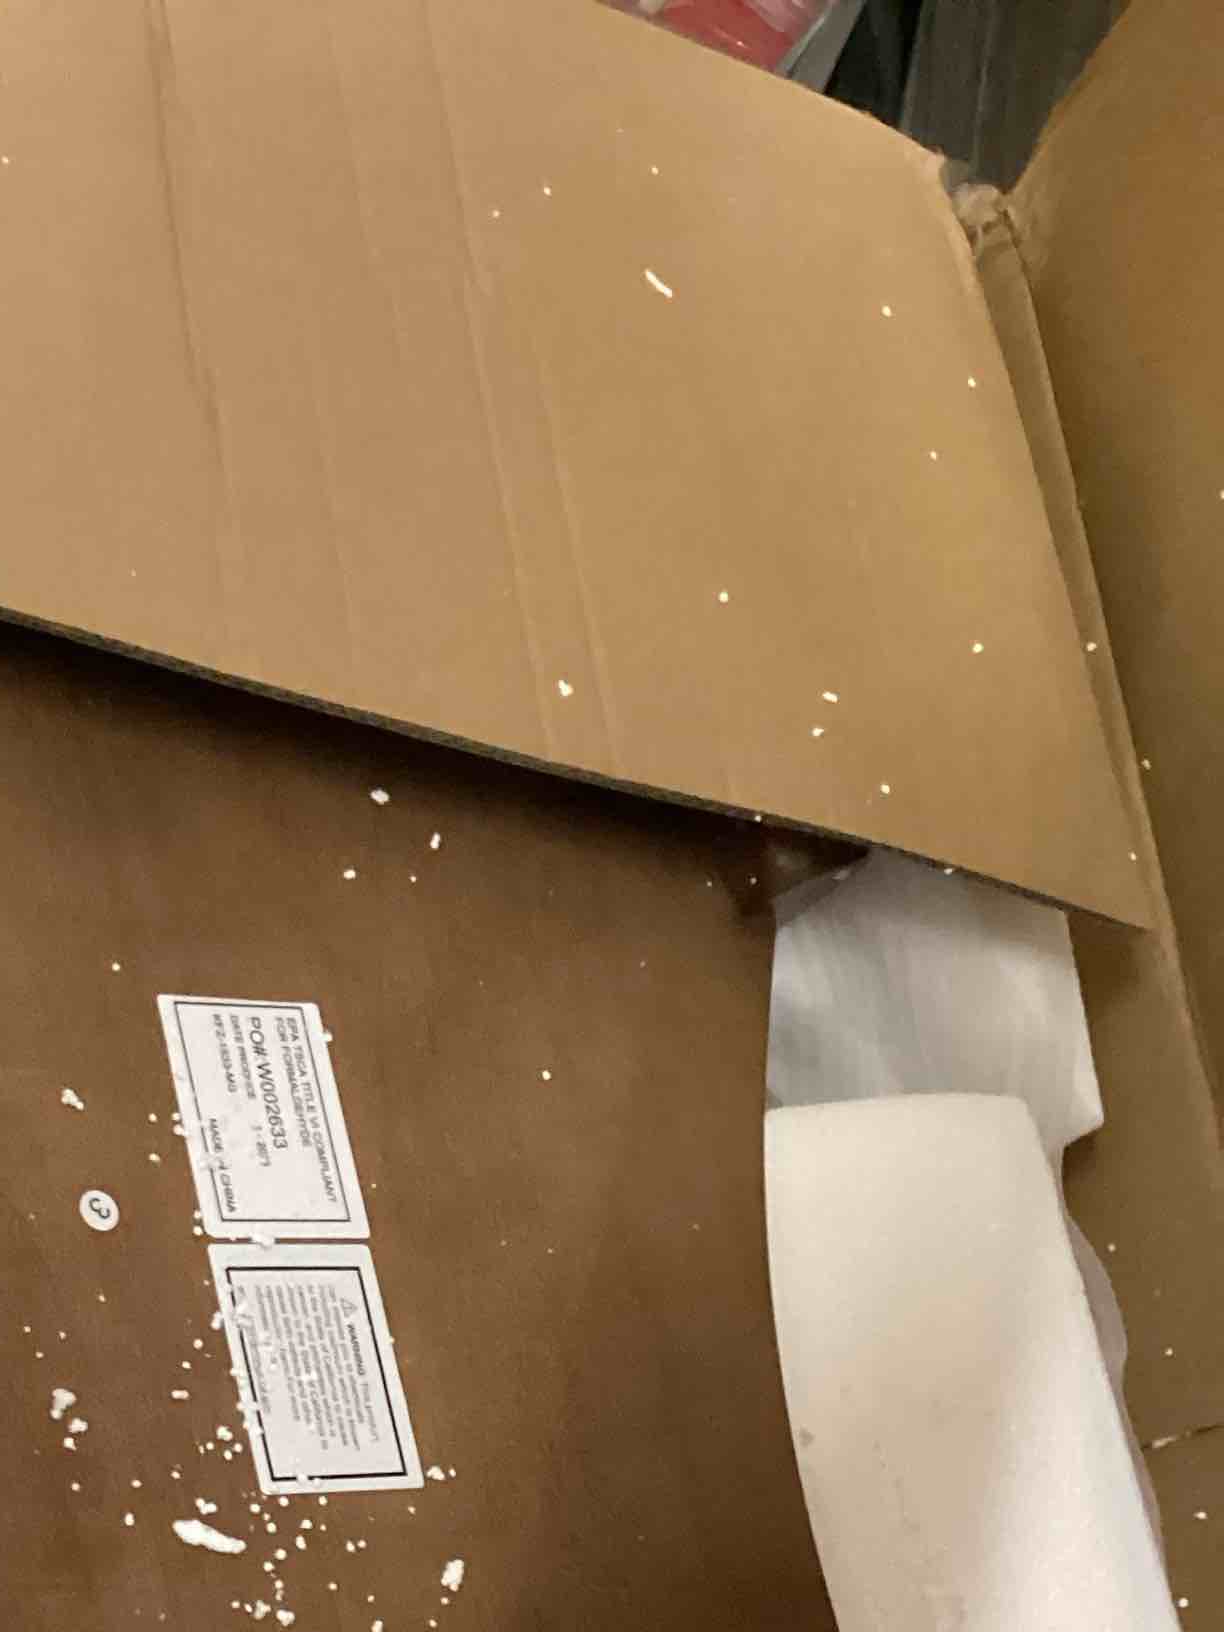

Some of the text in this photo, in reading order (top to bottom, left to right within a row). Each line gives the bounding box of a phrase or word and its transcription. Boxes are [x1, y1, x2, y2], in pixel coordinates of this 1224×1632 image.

[244, 1015, 290, 1149] PO# W002633
[300, 1081, 317, 1112] TITLE
[311, 1132, 337, 1202] COMPLIANT
